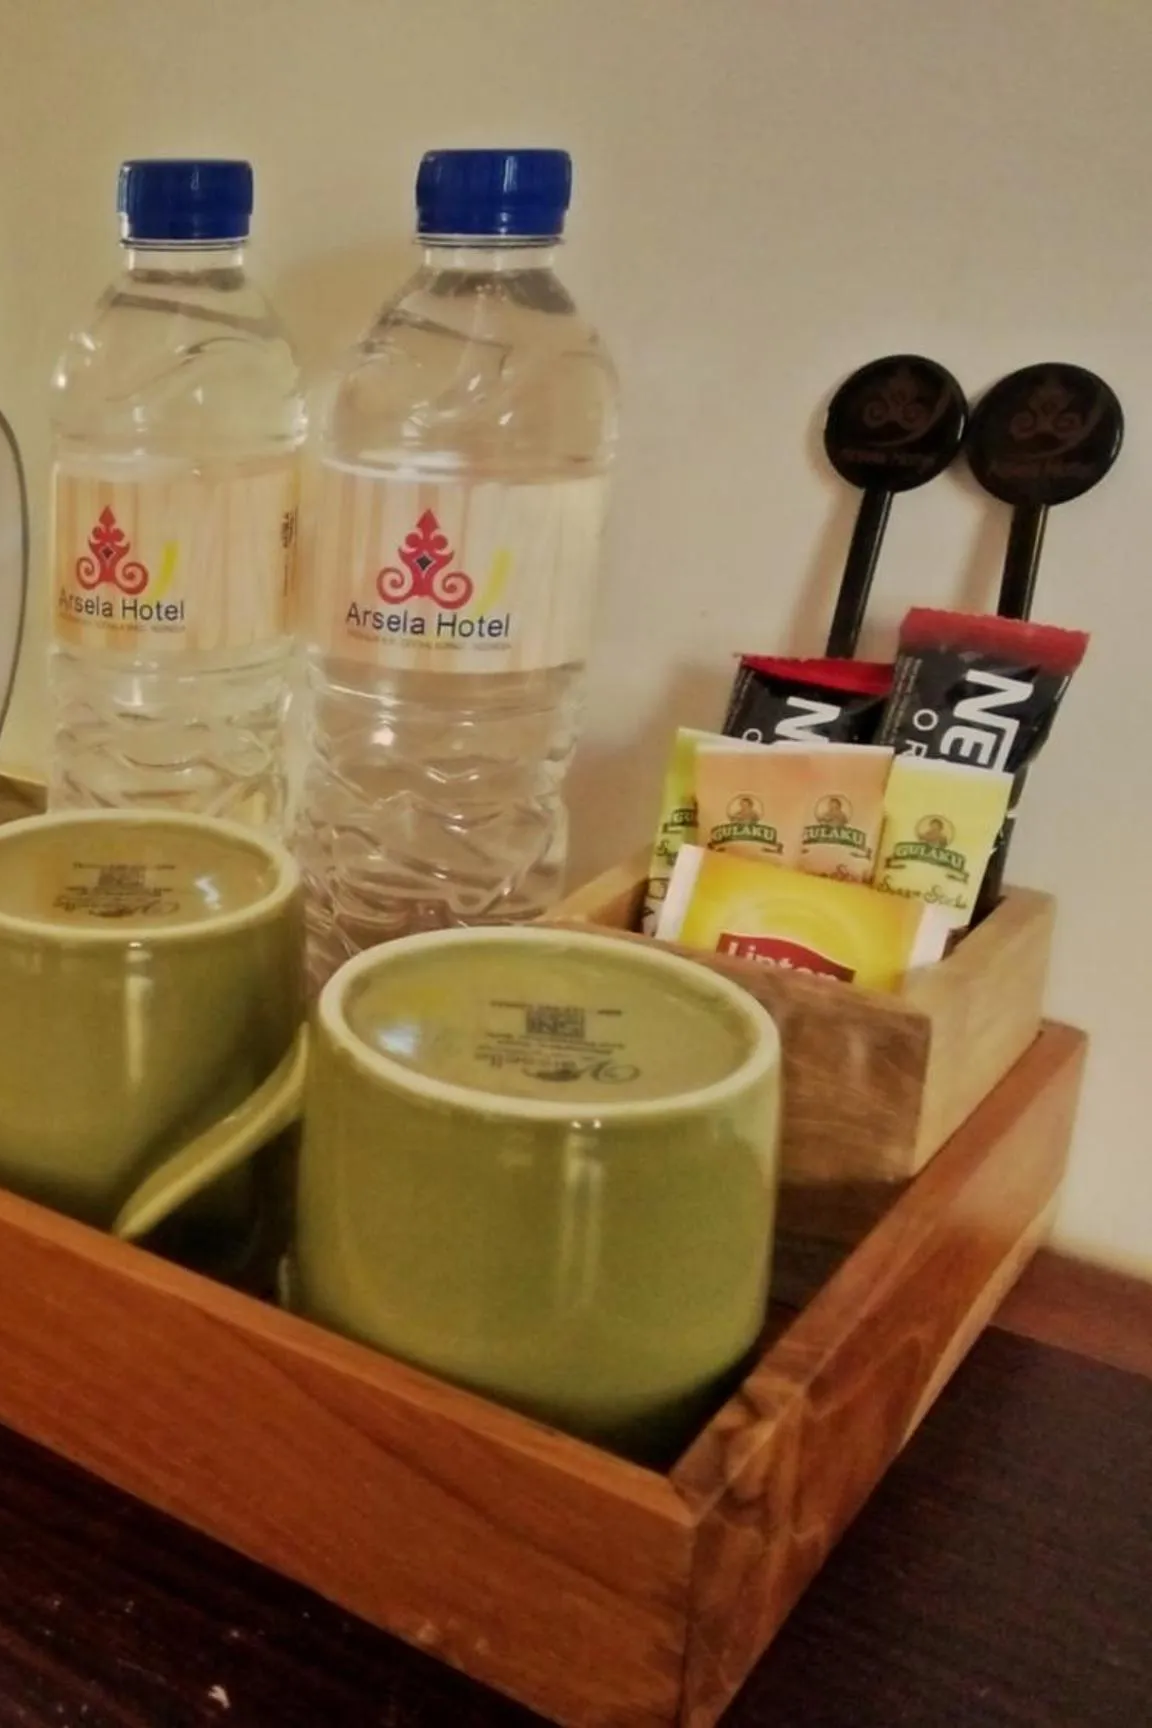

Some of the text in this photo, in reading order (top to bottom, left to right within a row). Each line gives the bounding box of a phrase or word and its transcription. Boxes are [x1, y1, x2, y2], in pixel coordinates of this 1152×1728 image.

[58, 586, 185, 621] Arsela Hotel
[346, 601, 511, 637] Arsela Hotel
[894, 843, 964, 869] GULAKU
